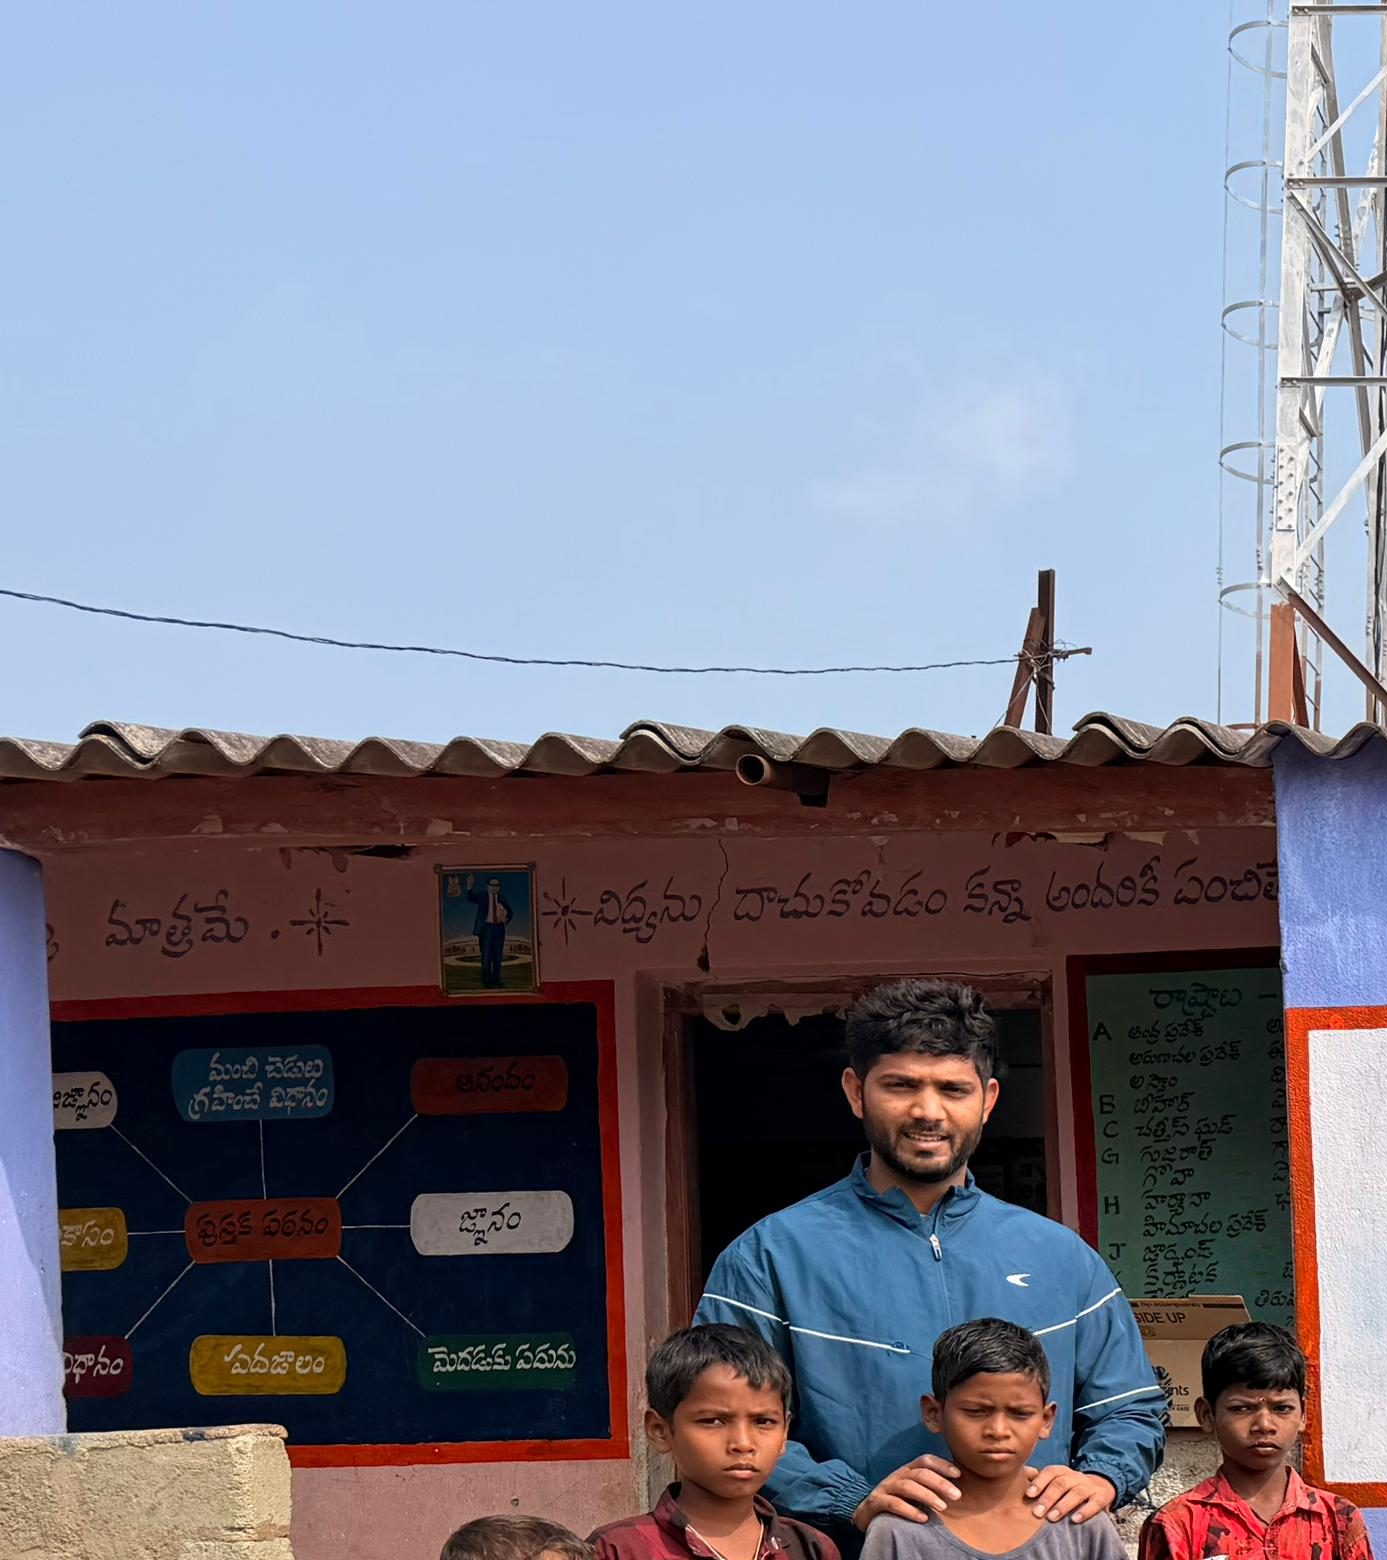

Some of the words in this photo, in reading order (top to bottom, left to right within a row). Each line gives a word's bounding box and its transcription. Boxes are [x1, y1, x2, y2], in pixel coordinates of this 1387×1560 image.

[594, 877, 702, 943] విద్యను
[734, 869, 947, 921] దాచుకోవడం
[964, 865, 1031, 923] కన్నా
[1093, 1022, 1112, 1040] A
[208, 1052, 259, 1080] మంచి
[188, 1082, 264, 1120] గ్రహించే
[269, 1080, 329, 1115] విధానం
[1099, 1095, 1115, 1114] B
[1103, 1121, 1119, 1138] C
[1101, 1148, 1119, 1164] G
[1104, 1196, 1120, 1214] H
[197, 1210, 253, 1247] పుస్తక
[262, 1209, 329, 1237] పఠనం
[1109, 1243, 1126, 1260] J
[1167, 1312, 1187, 1323] UP
[224, 1343, 327, 1375] పదజాలం
